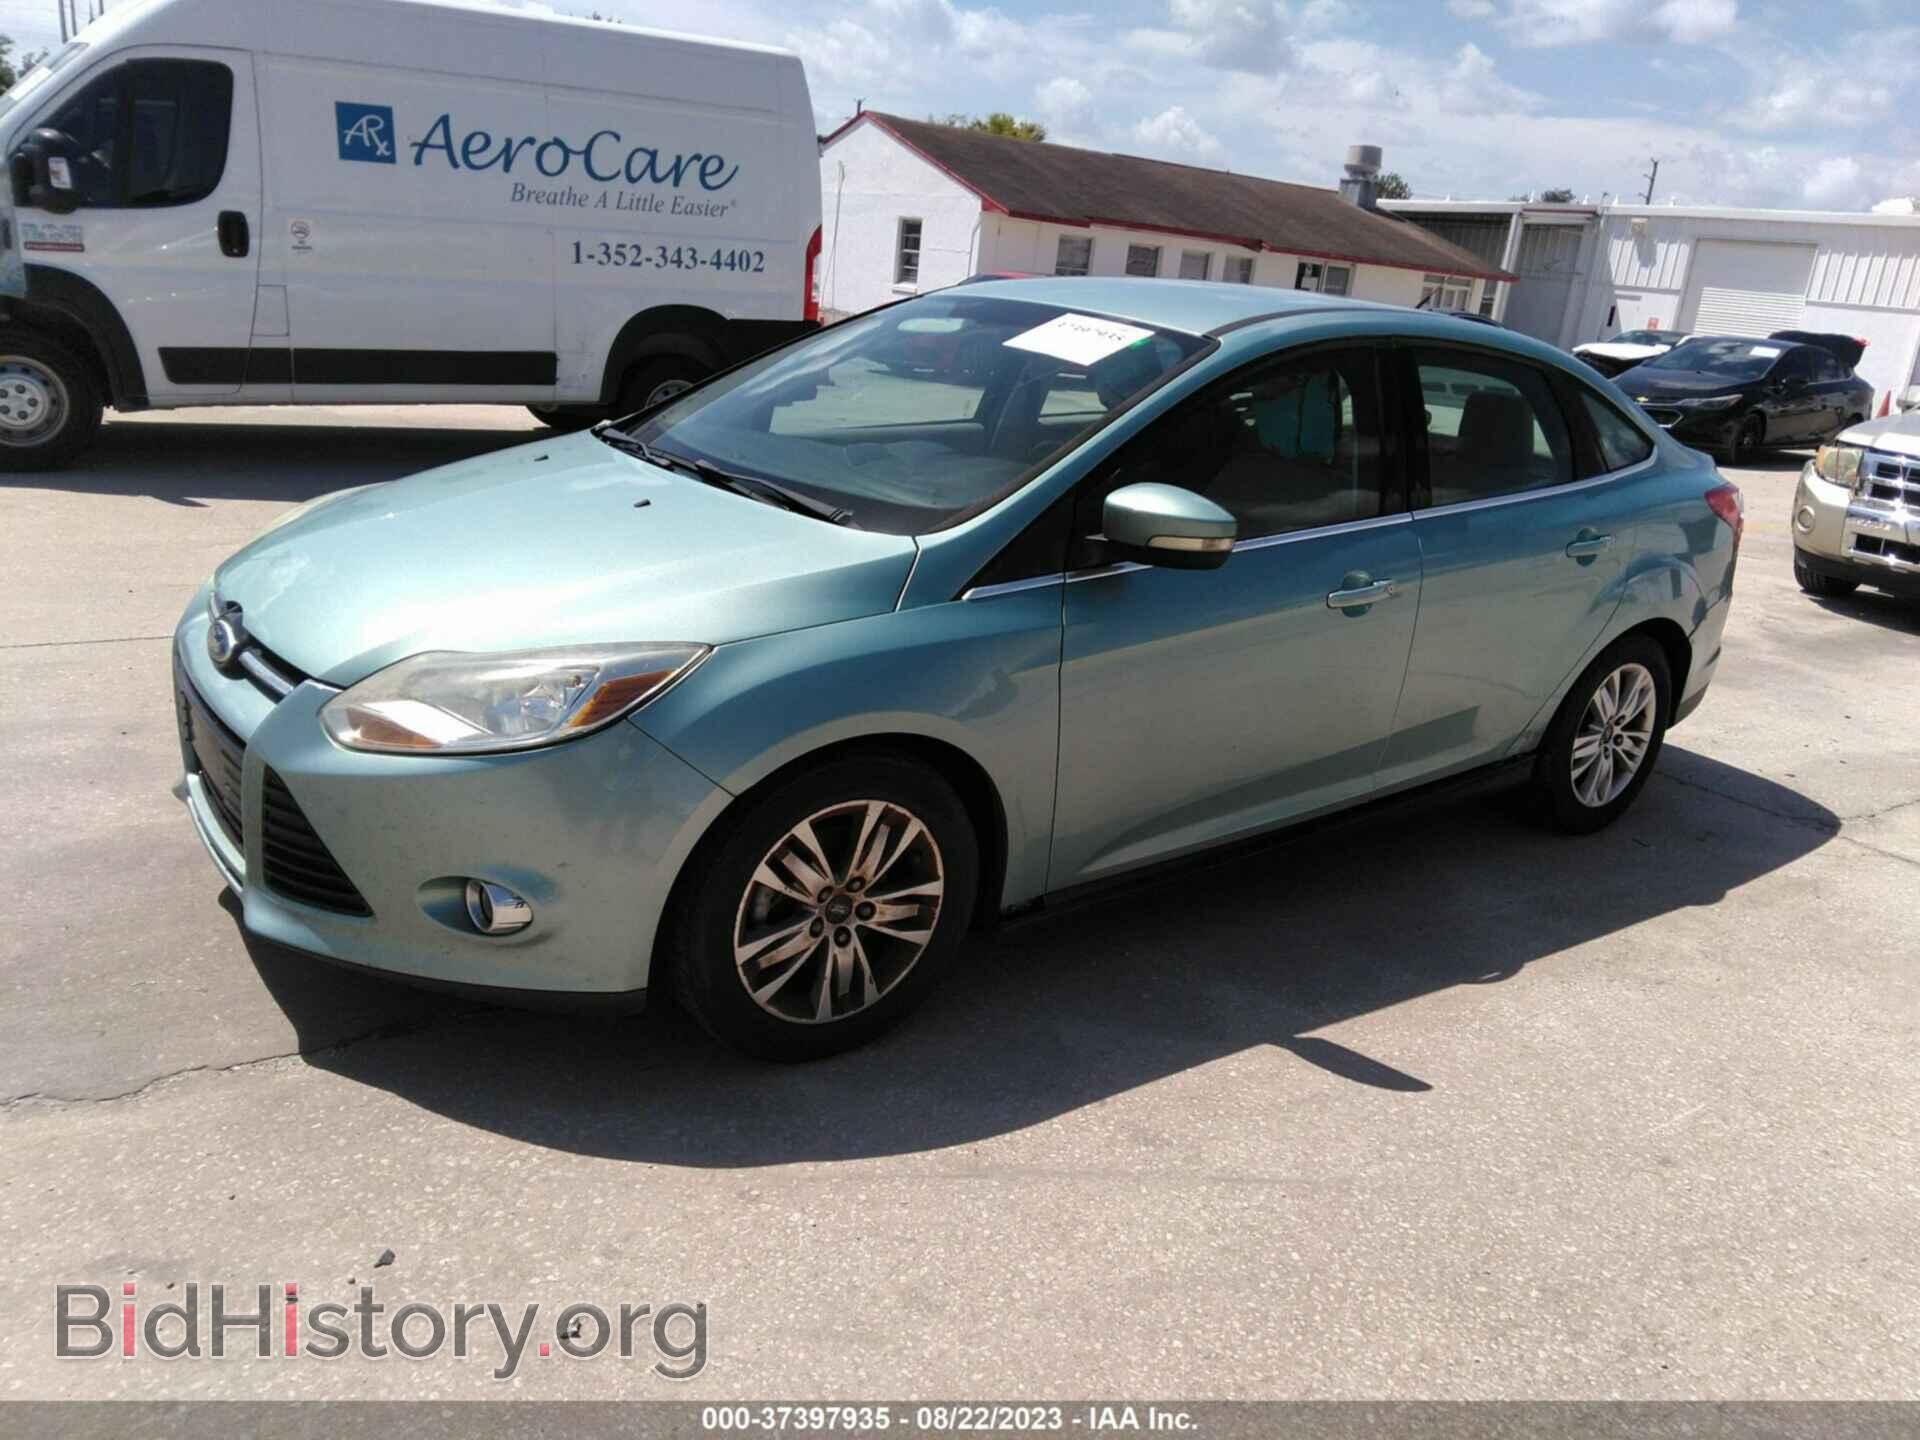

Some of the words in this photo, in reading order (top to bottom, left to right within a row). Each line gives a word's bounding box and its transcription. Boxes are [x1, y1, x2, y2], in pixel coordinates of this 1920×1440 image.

[410, 113, 740, 191] AeroCare
[510, 182, 589, 209] Breathe
[594, 191, 609, 210] A
[615, 193, 665, 214] Little
[571, 240, 766, 273] 1-352-343-4402
